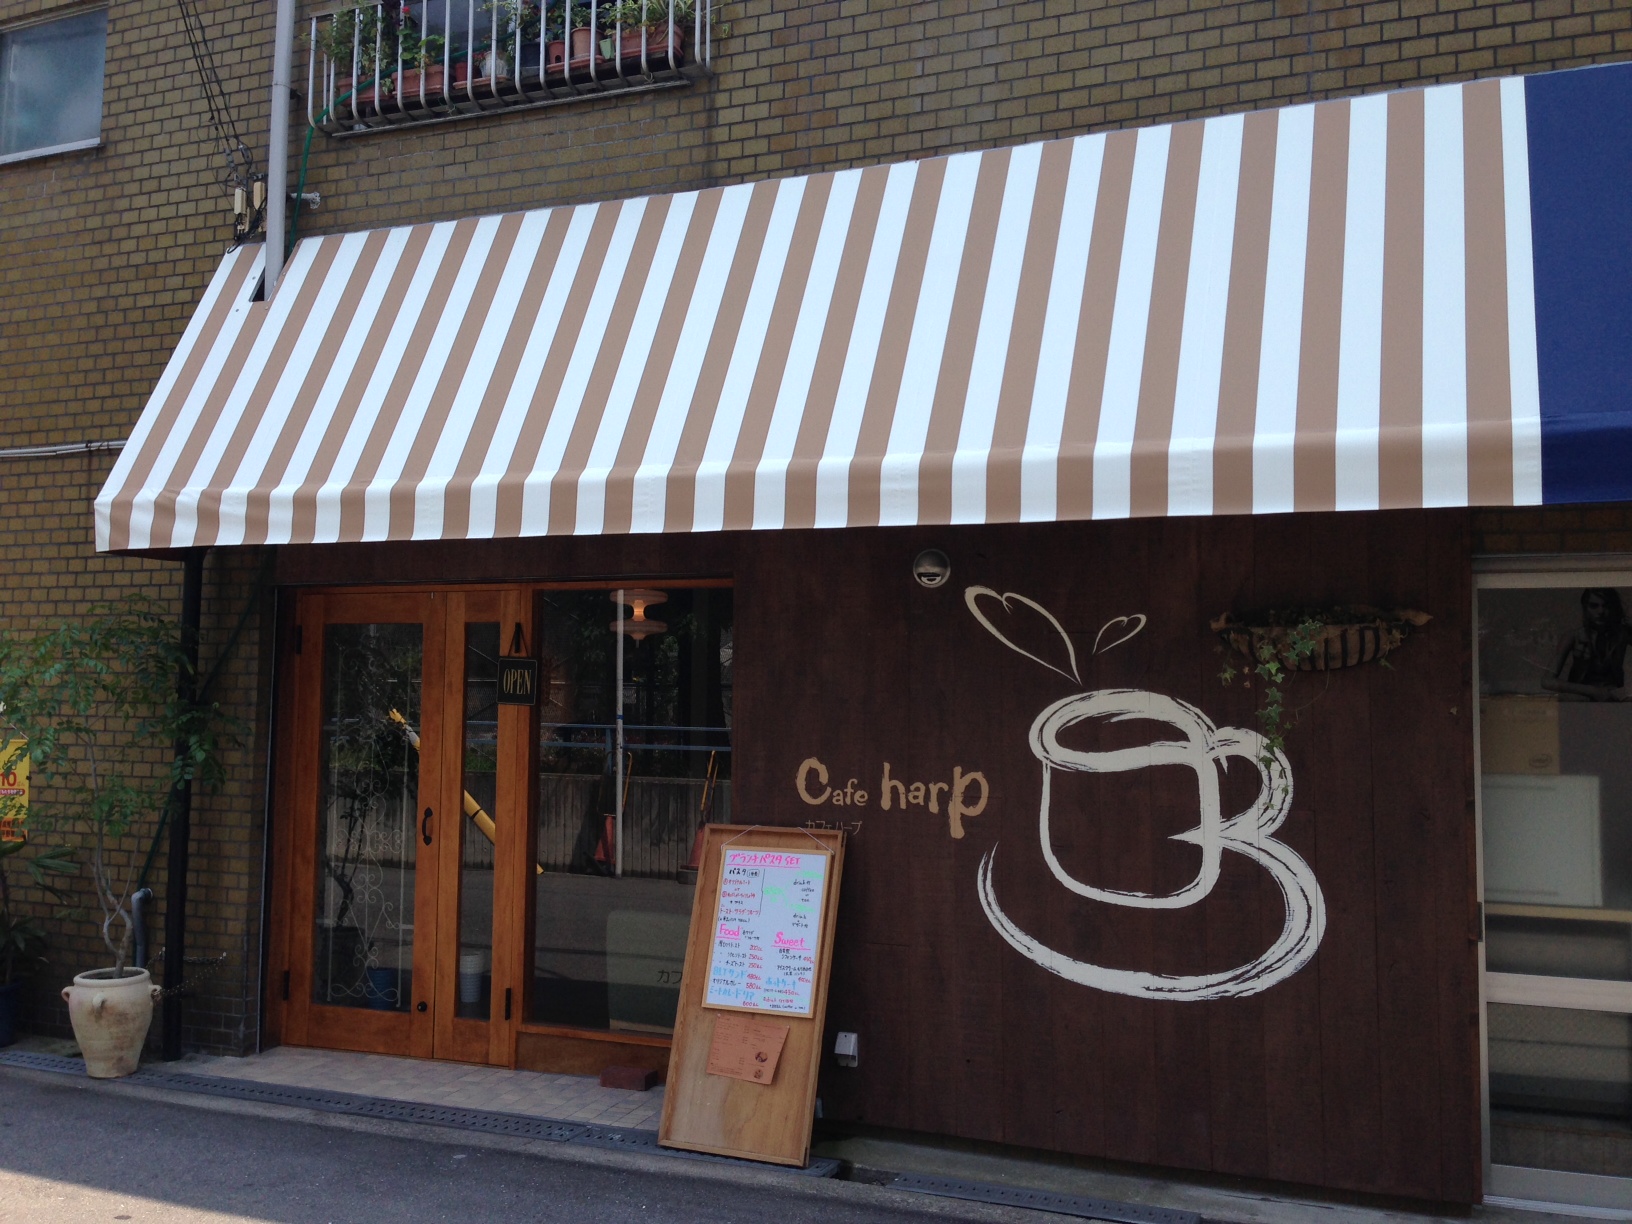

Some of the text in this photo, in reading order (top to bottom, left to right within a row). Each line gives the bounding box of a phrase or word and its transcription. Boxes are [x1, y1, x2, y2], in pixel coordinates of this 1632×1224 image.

[503, 669, 532, 695] OPEN
[796, 757, 989, 839] Cafe harp
[785, 855, 800, 865] SET
[720, 924, 740, 936] Food
[774, 932, 804, 947] Sweet
